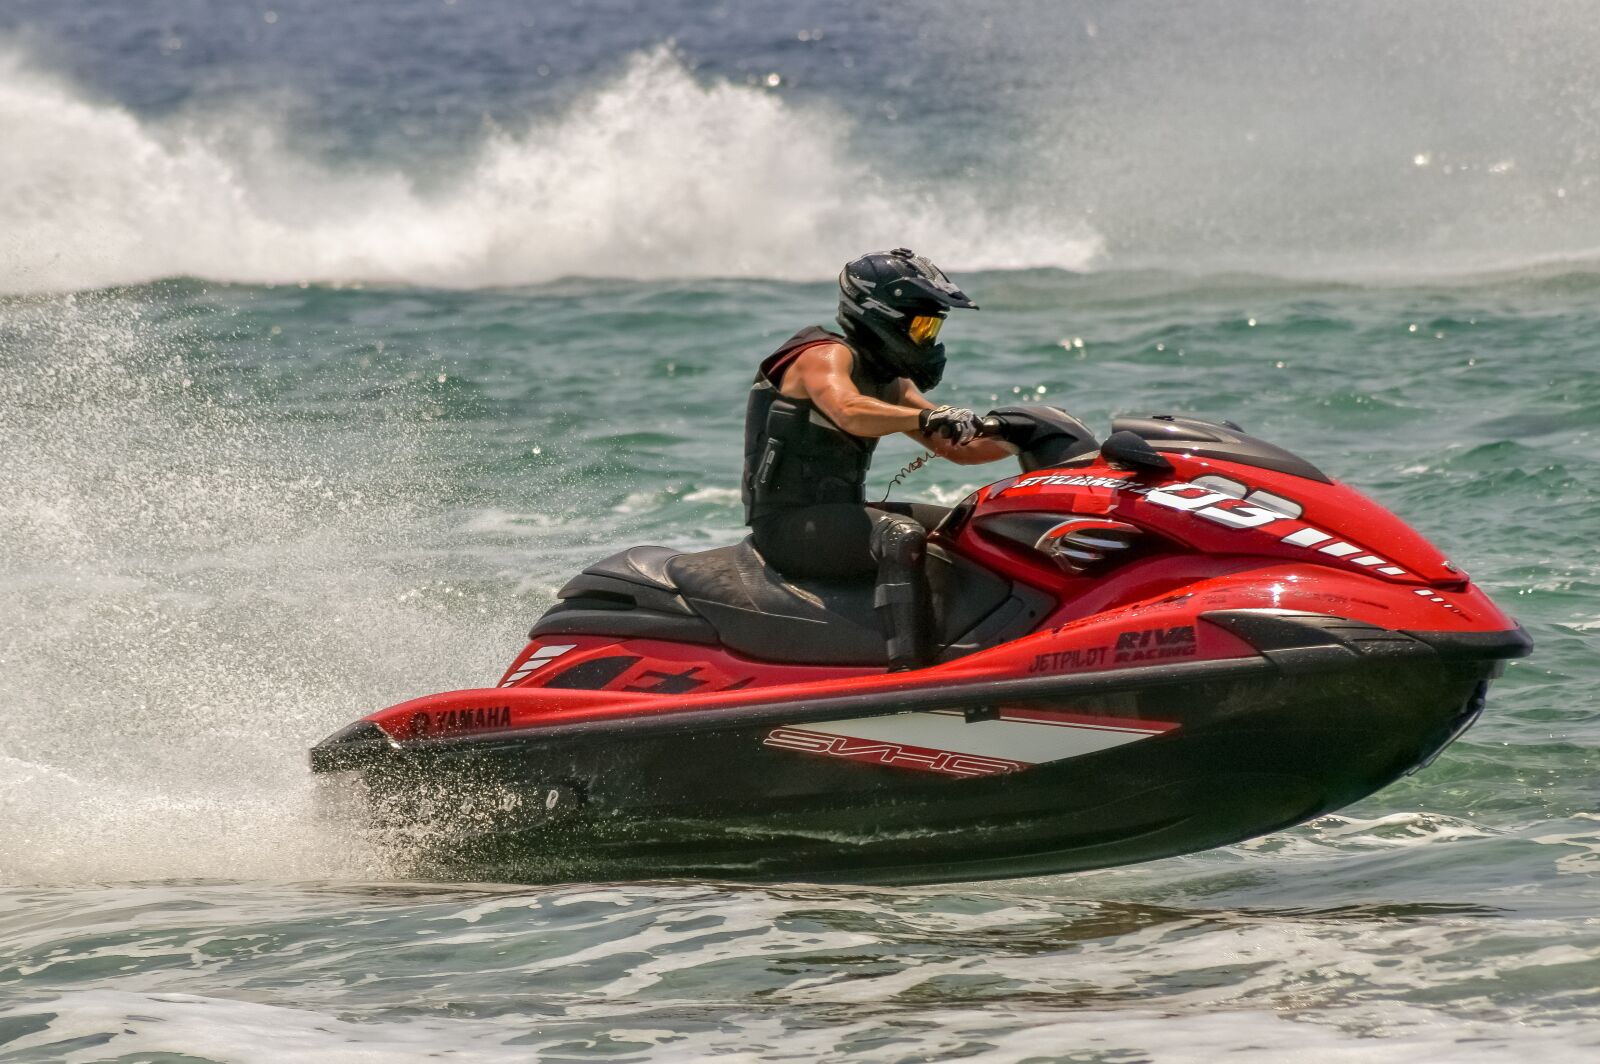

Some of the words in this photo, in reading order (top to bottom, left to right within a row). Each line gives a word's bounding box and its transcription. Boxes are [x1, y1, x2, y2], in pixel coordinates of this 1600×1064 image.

[1116, 625, 1195, 650] RIVA
[1029, 646, 1108, 673] JETPILOT
[436, 706, 511, 731] YAMAHA
